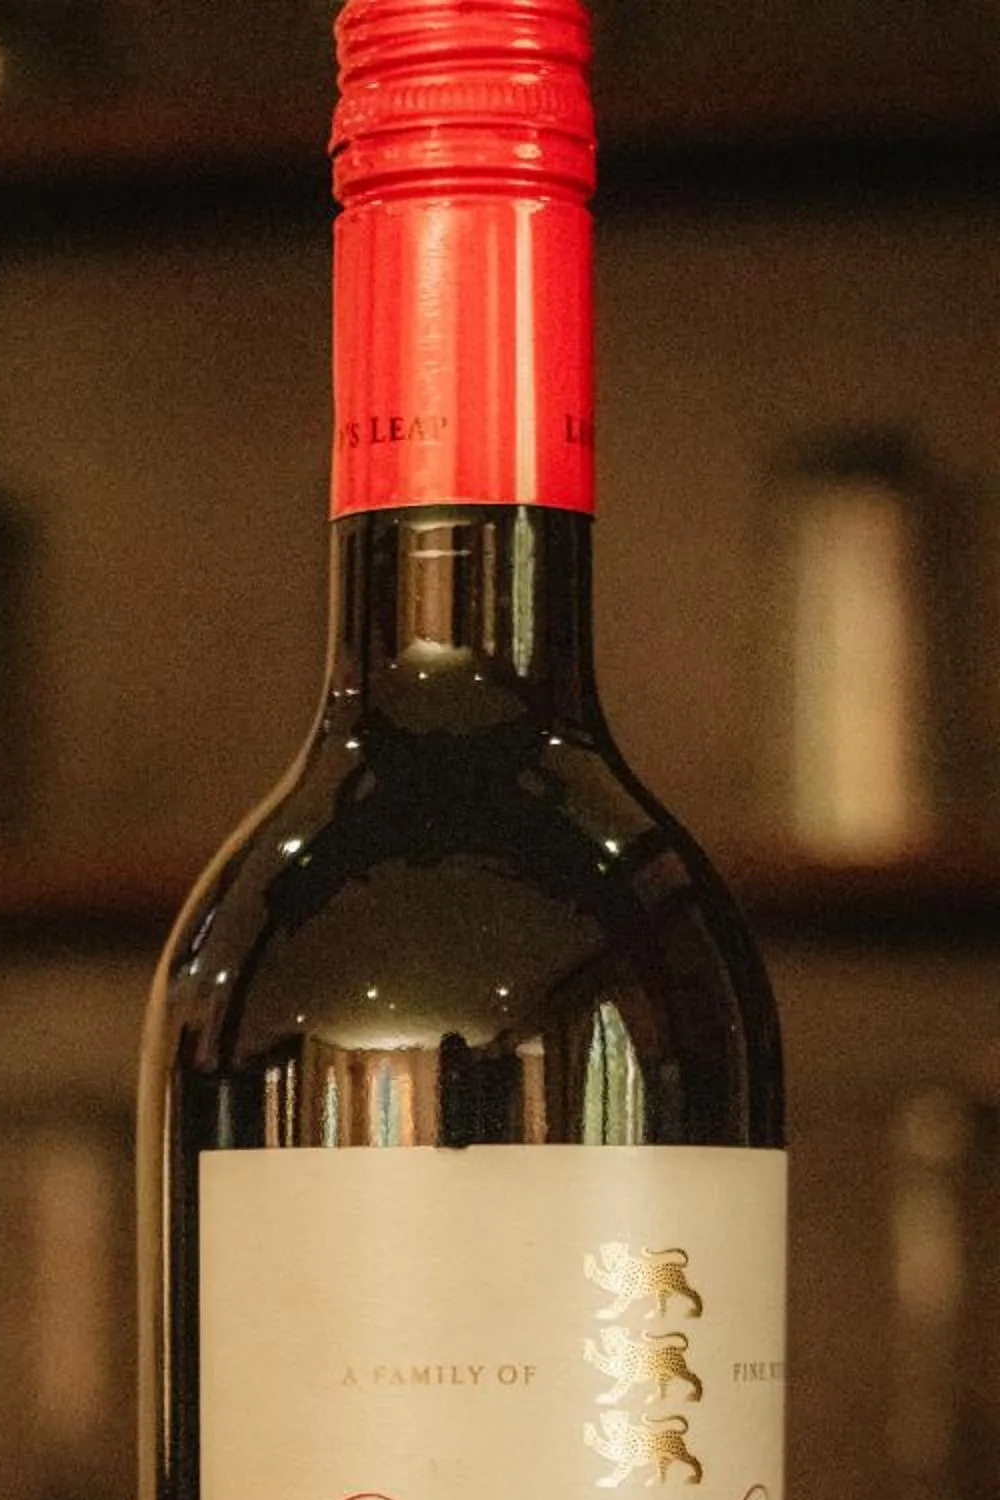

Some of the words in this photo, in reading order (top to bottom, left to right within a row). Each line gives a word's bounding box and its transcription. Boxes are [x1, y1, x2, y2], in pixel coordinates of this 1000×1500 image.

[342, 1366, 358, 1386] A
[373, 1365, 486, 1386] FAMILY
[497, 1364, 537, 1386] OF
[732, 1361, 766, 1382] FINE
